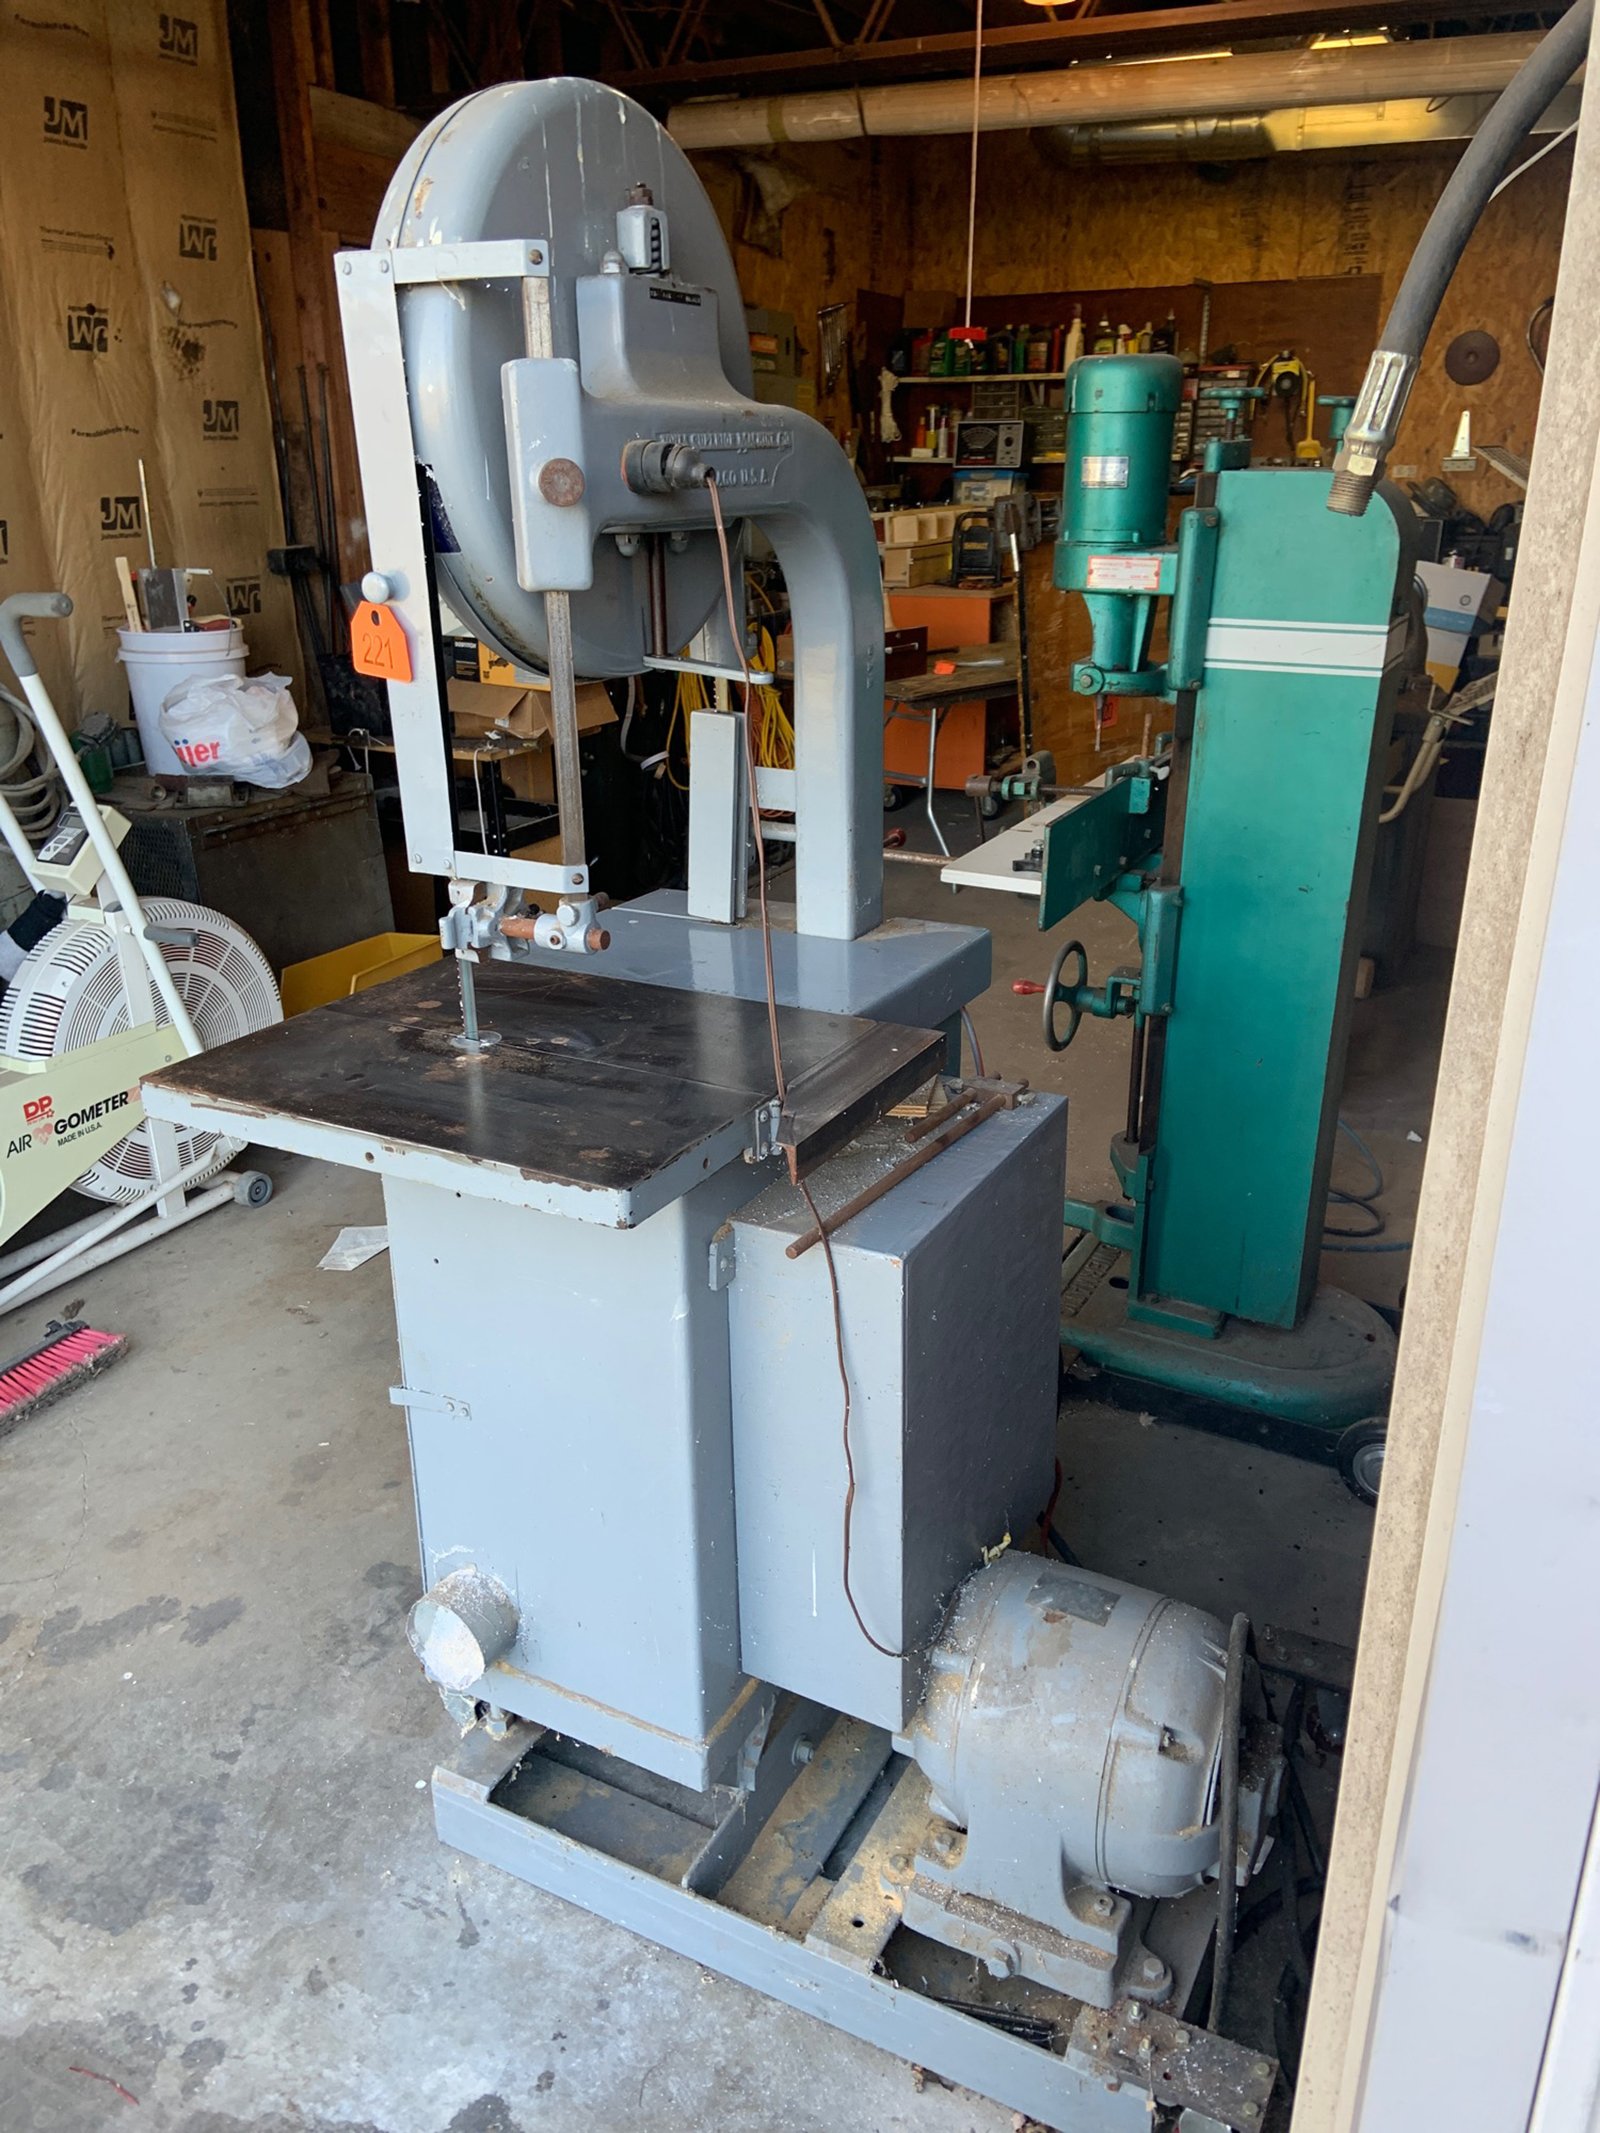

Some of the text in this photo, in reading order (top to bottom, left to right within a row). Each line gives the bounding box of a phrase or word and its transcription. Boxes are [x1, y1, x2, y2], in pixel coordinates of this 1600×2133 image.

[159, 14, 198, 56] JM
[43, 96, 88, 140] JM
[203, 400, 239, 432] JM
[101, 496, 142, 530] JM
[362, 631, 394, 670] 221
[174, 738, 220, 767] ijer
[23, 1095, 52, 1119] DP
[7, 1091, 129, 1158] AIR GOMETER
[57, 1133, 77, 1147] MADE
[77, 1130, 85, 1138] IN
